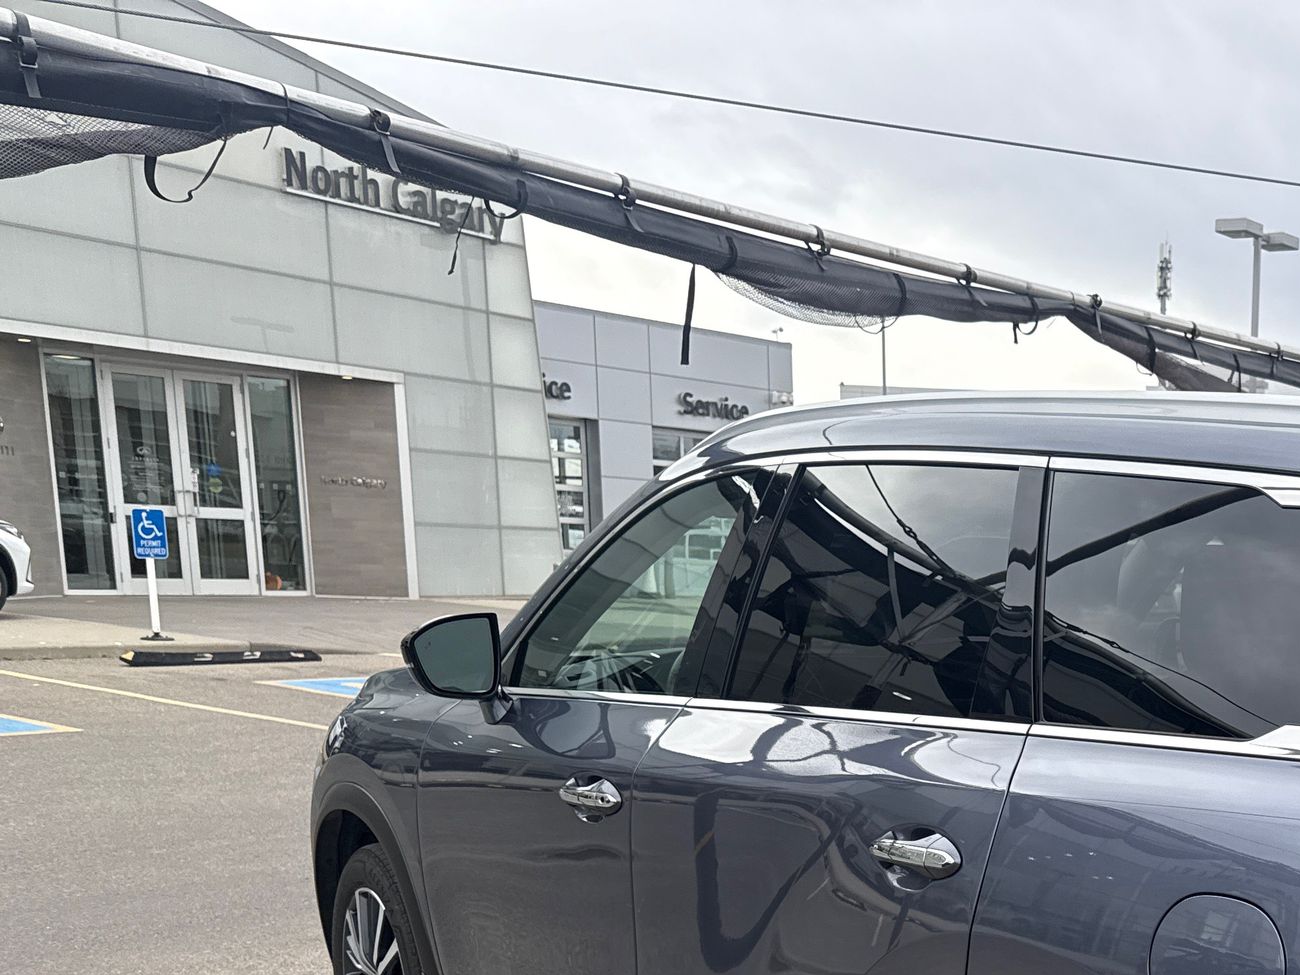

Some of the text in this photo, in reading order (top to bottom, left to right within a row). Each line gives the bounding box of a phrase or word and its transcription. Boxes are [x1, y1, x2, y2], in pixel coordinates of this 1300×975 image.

[283, 147, 506, 244] North Calgary
[680, 391, 750, 421] Service
[137, 547, 167, 556] REQUIRED
[140, 539, 162, 548] PERMIT
